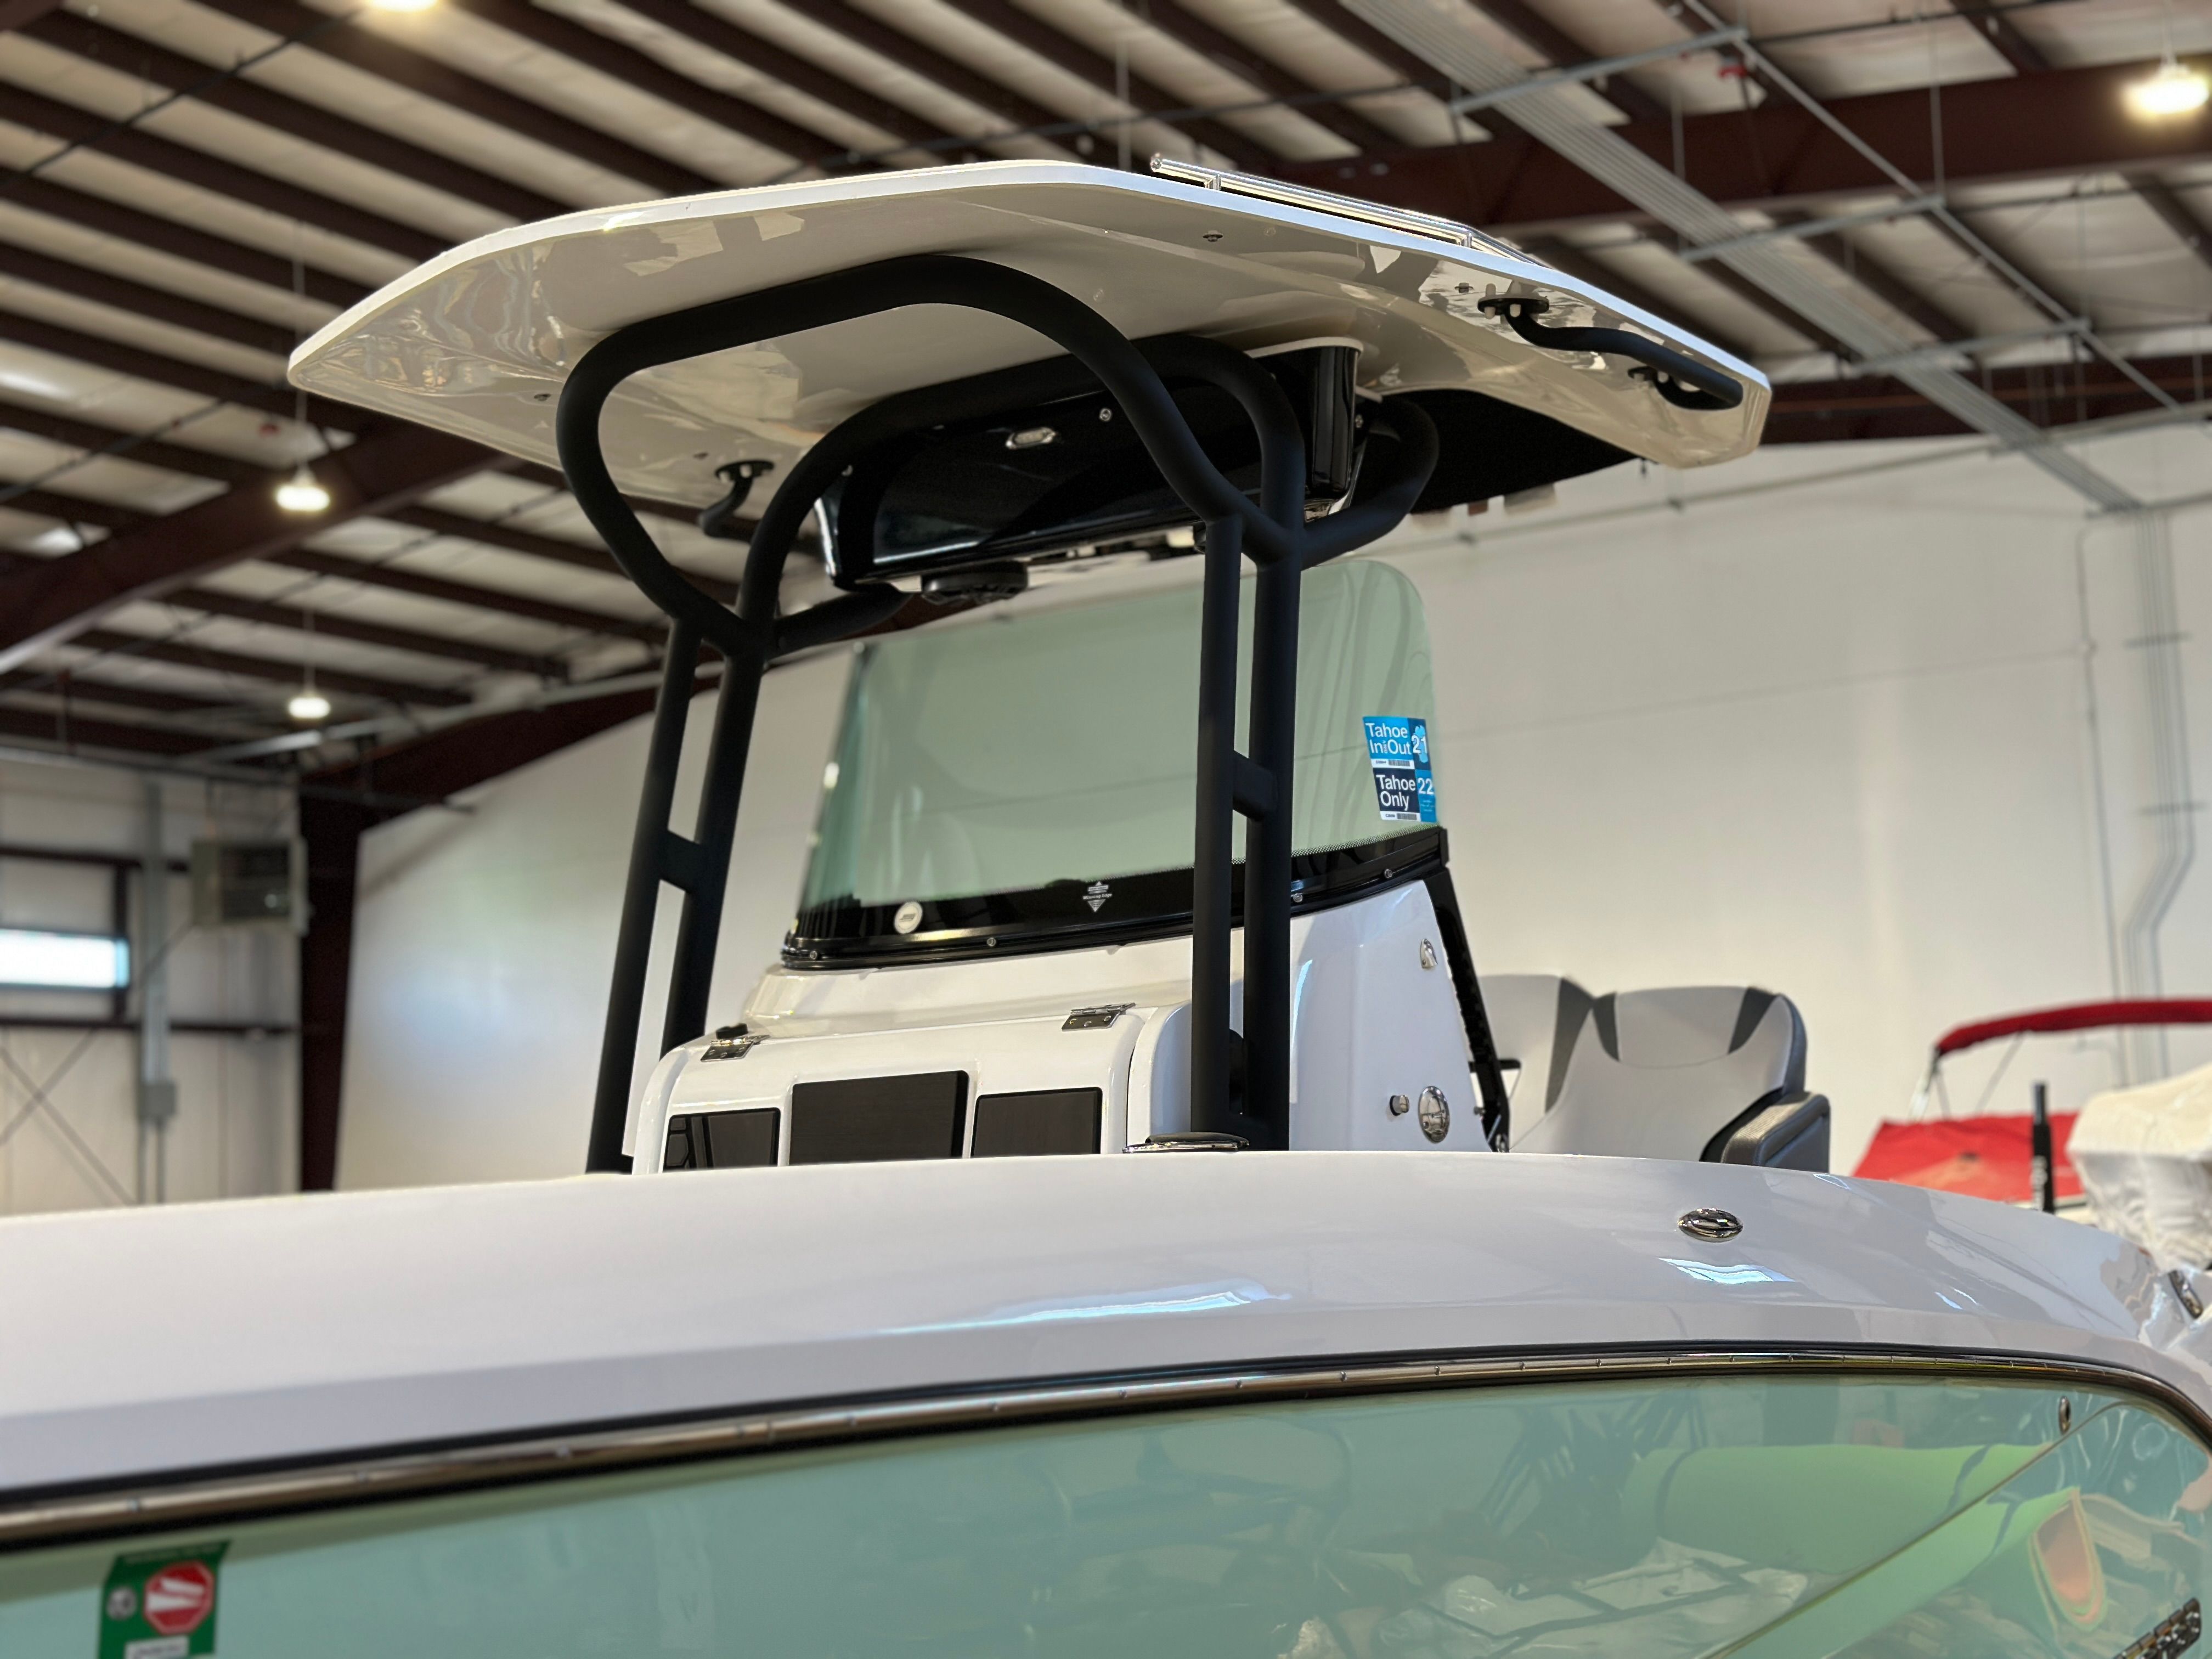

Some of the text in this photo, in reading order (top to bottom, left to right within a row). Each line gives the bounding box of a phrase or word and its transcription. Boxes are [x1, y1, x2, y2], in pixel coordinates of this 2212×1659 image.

[1365, 723, 1408, 738] Tahoe
[1370, 739, 1384, 753] In
[1388, 739, 1412, 754] Out
[1411, 735, 1427, 753] 21
[1376, 775, 1415, 791] Tahoe
[1418, 777, 1434, 794] 22
[1380, 791, 1409, 811] Only
